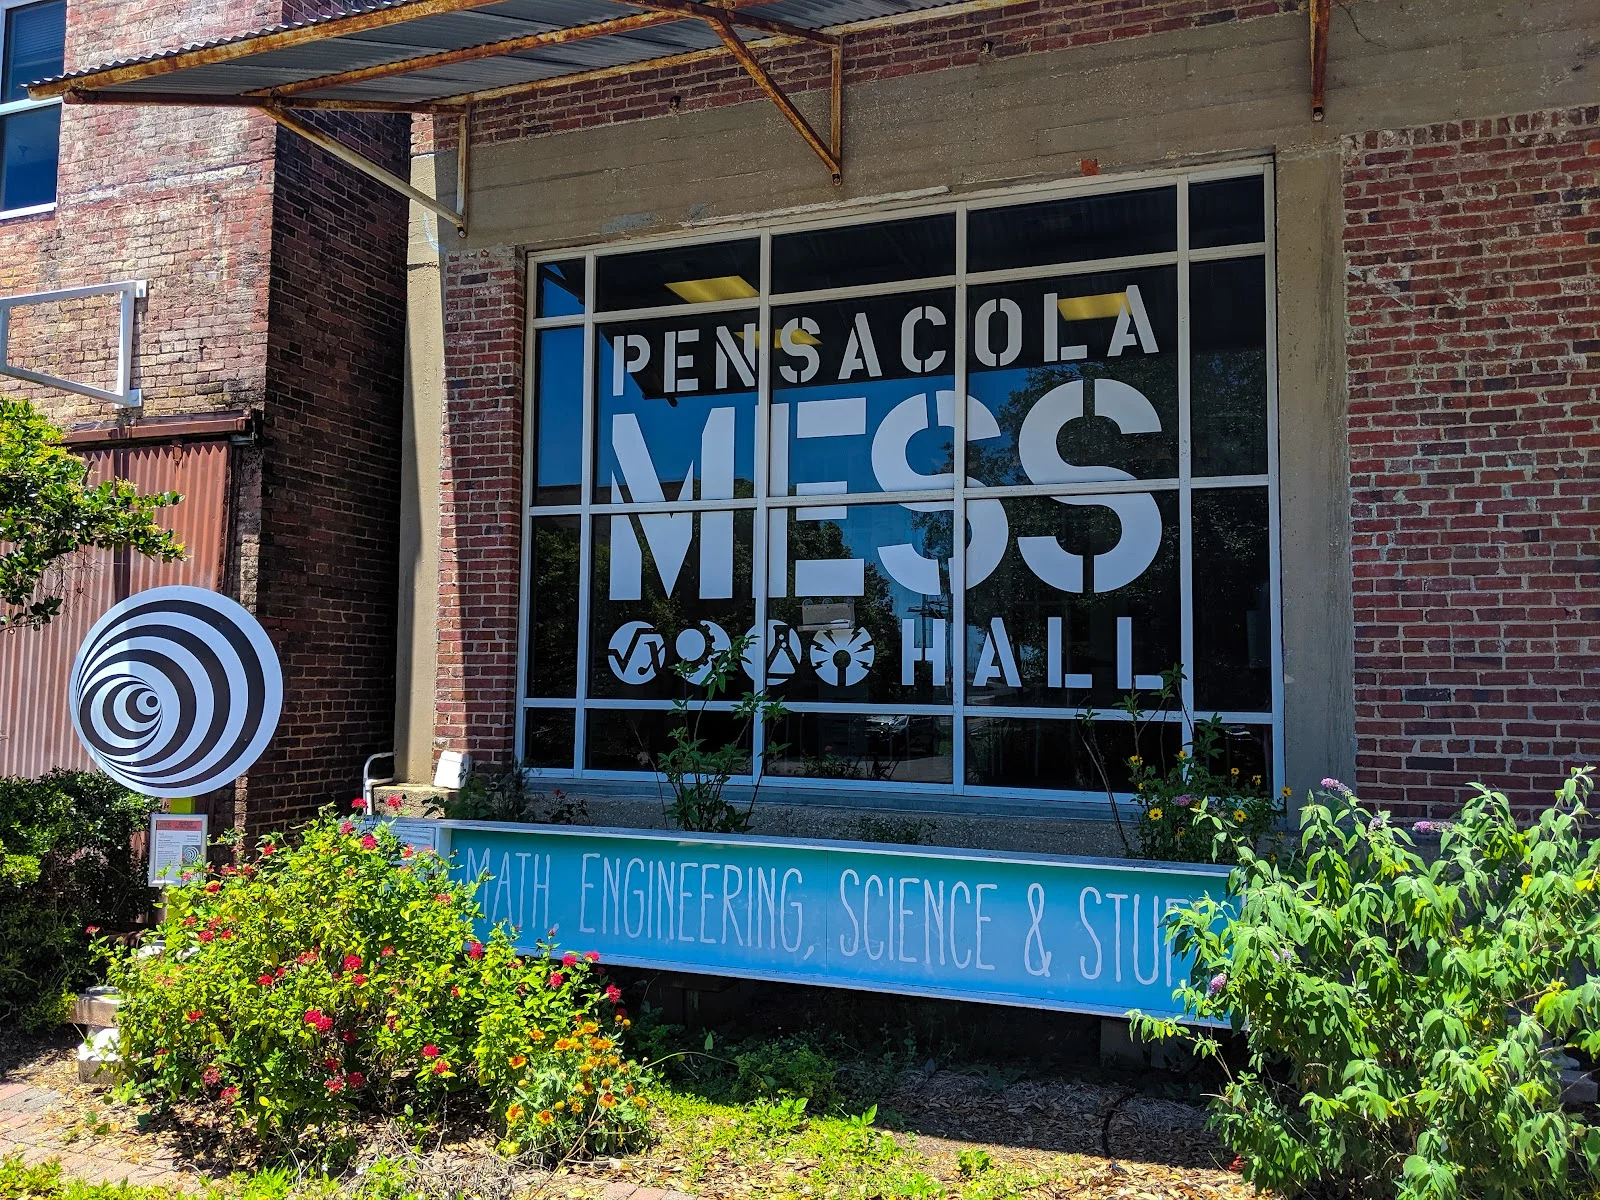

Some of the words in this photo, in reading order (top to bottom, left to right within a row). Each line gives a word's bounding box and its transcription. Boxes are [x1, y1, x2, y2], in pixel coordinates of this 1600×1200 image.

[613, 284, 1160, 397] PENSACOLA
[609, 378, 1163, 601] MESS
[901, 616, 1165, 691] HALL
[579, 852, 815, 961] ENGINEERING,
[839, 868, 998, 971] SCIENCE
[1023, 882, 1052, 978] &
[1079, 886, 1204, 988] STUF
